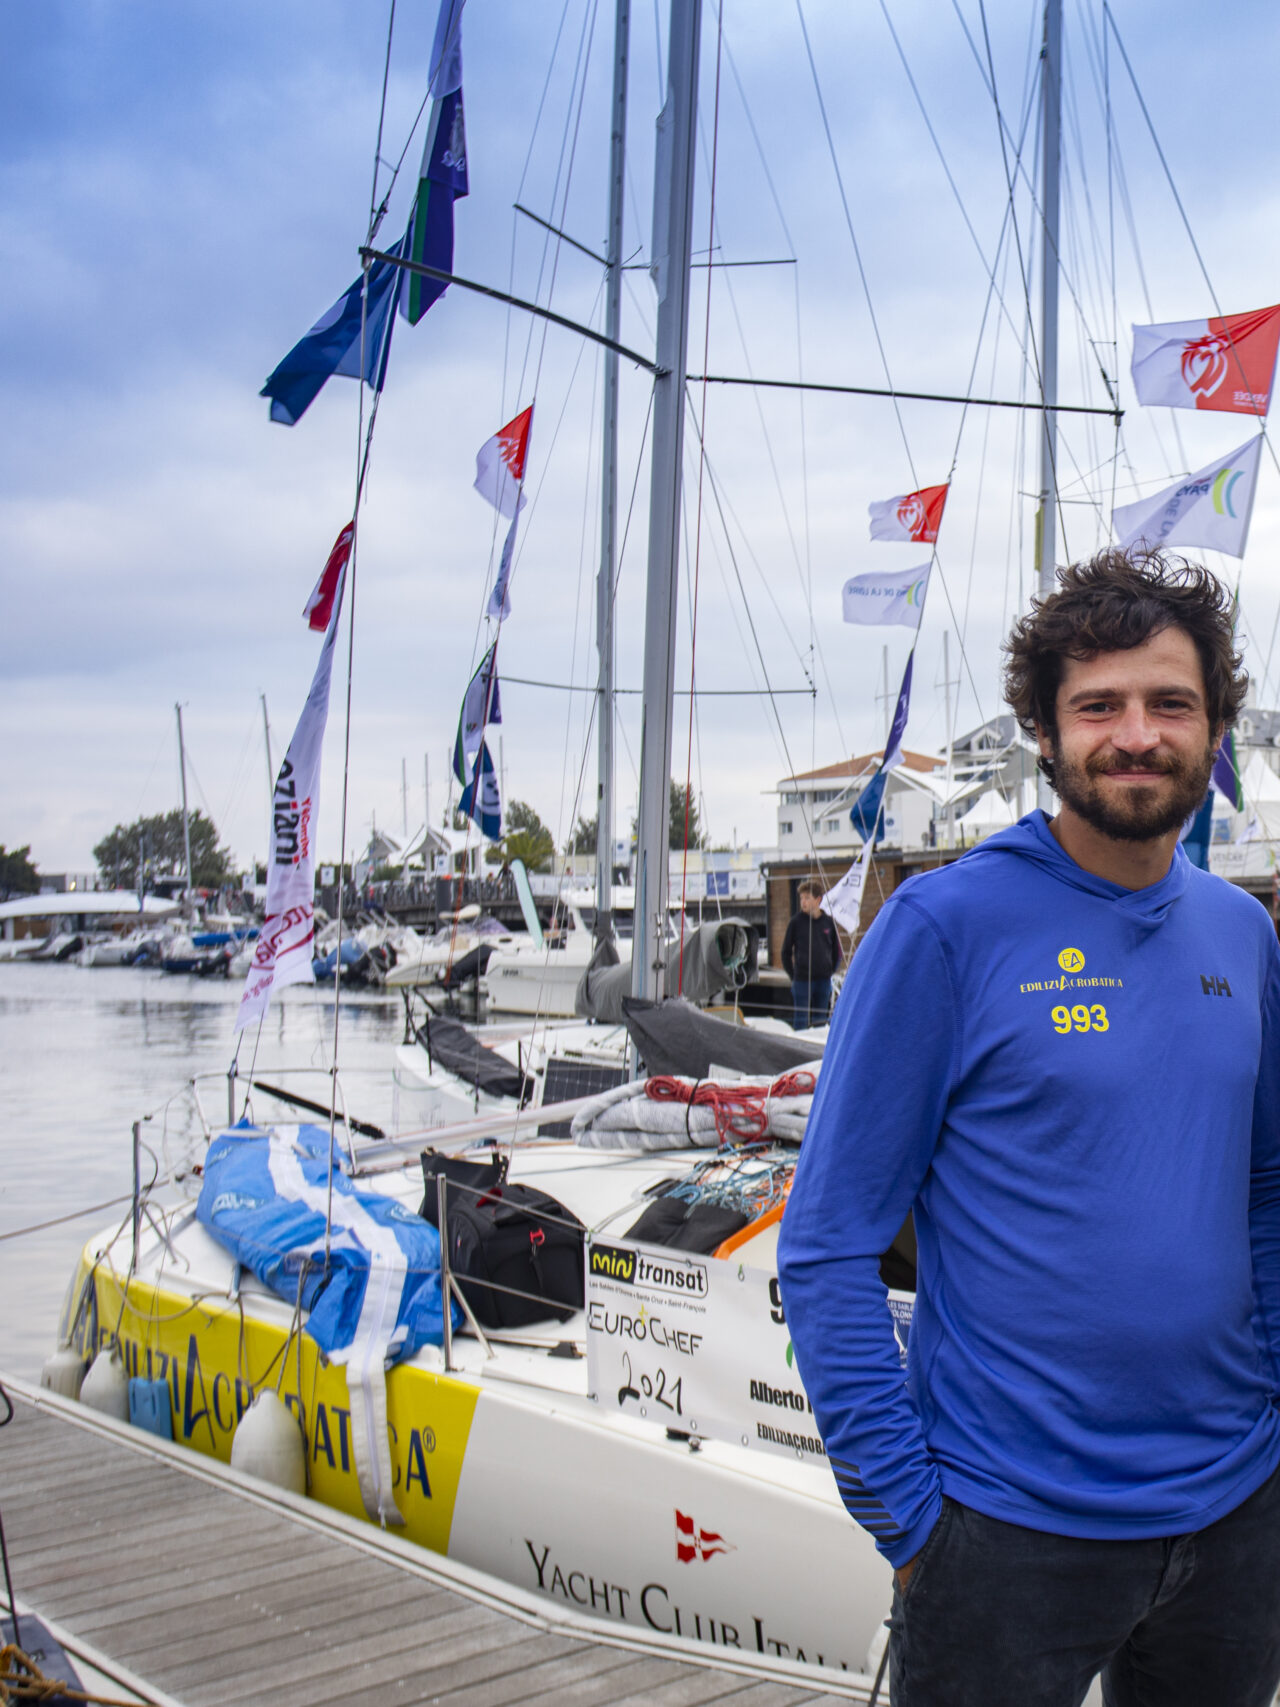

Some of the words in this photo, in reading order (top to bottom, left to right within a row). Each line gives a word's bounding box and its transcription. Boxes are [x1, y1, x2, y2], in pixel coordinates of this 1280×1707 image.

[1200, 974, 1233, 998] HH
[1051, 1004, 1110, 1034] 993
[638, 1259, 704, 1292] transat
[618, 1351, 682, 1416] 2021
[750, 1379, 804, 1413] Alberto
